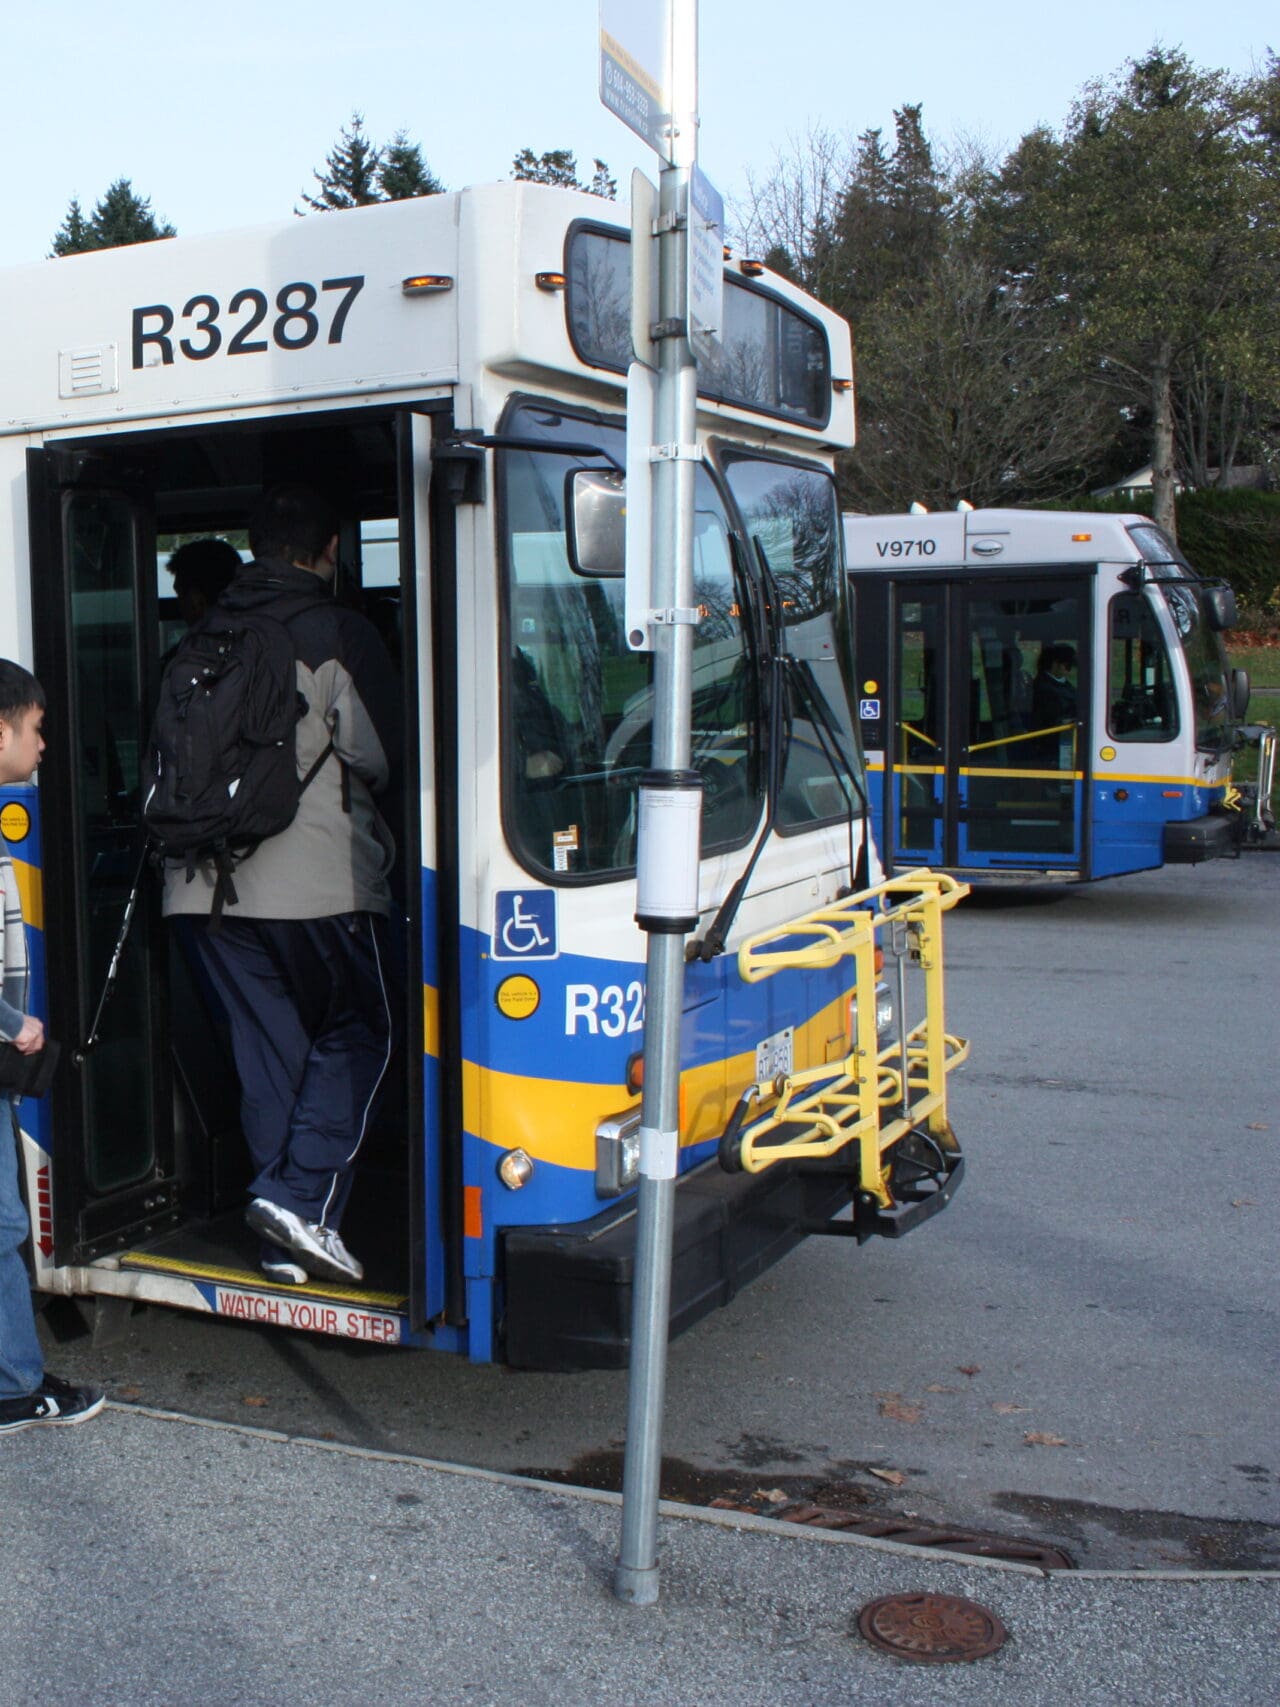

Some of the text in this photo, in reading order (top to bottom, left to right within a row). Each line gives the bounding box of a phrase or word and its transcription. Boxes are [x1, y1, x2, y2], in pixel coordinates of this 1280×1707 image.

[132, 275, 365, 370] R3287
[876, 539, 936, 558] V9710
[564, 980, 646, 1038] R32
[219, 1291, 395, 1343] WATCH YOUR STEP
